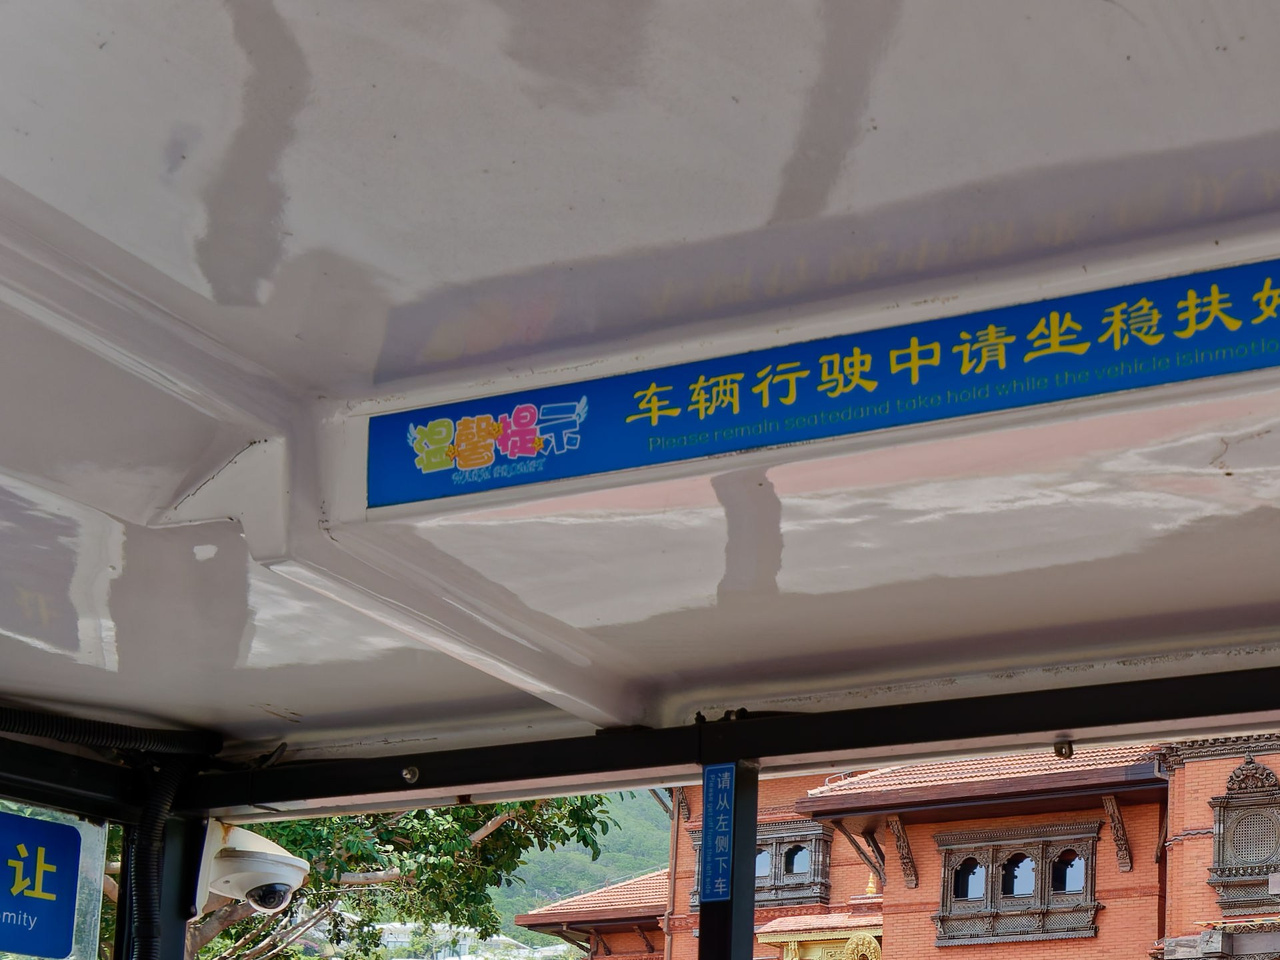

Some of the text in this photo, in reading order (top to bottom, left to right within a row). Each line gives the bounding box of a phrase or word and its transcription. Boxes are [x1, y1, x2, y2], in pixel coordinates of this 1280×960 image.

[648, 428, 709, 451] Please
[713, 421, 780, 442] remain
[896, 393, 942, 414] take
[946, 384, 990, 405] hold
[995, 376, 1048, 397] while
[1054, 369, 1090, 387] the
[1095, 356, 1171, 380] vehicle
[713, 772, 731, 895] 请从左侧下车
[7, 843, 57, 901] 让
[0, 910, 38, 931] mity
